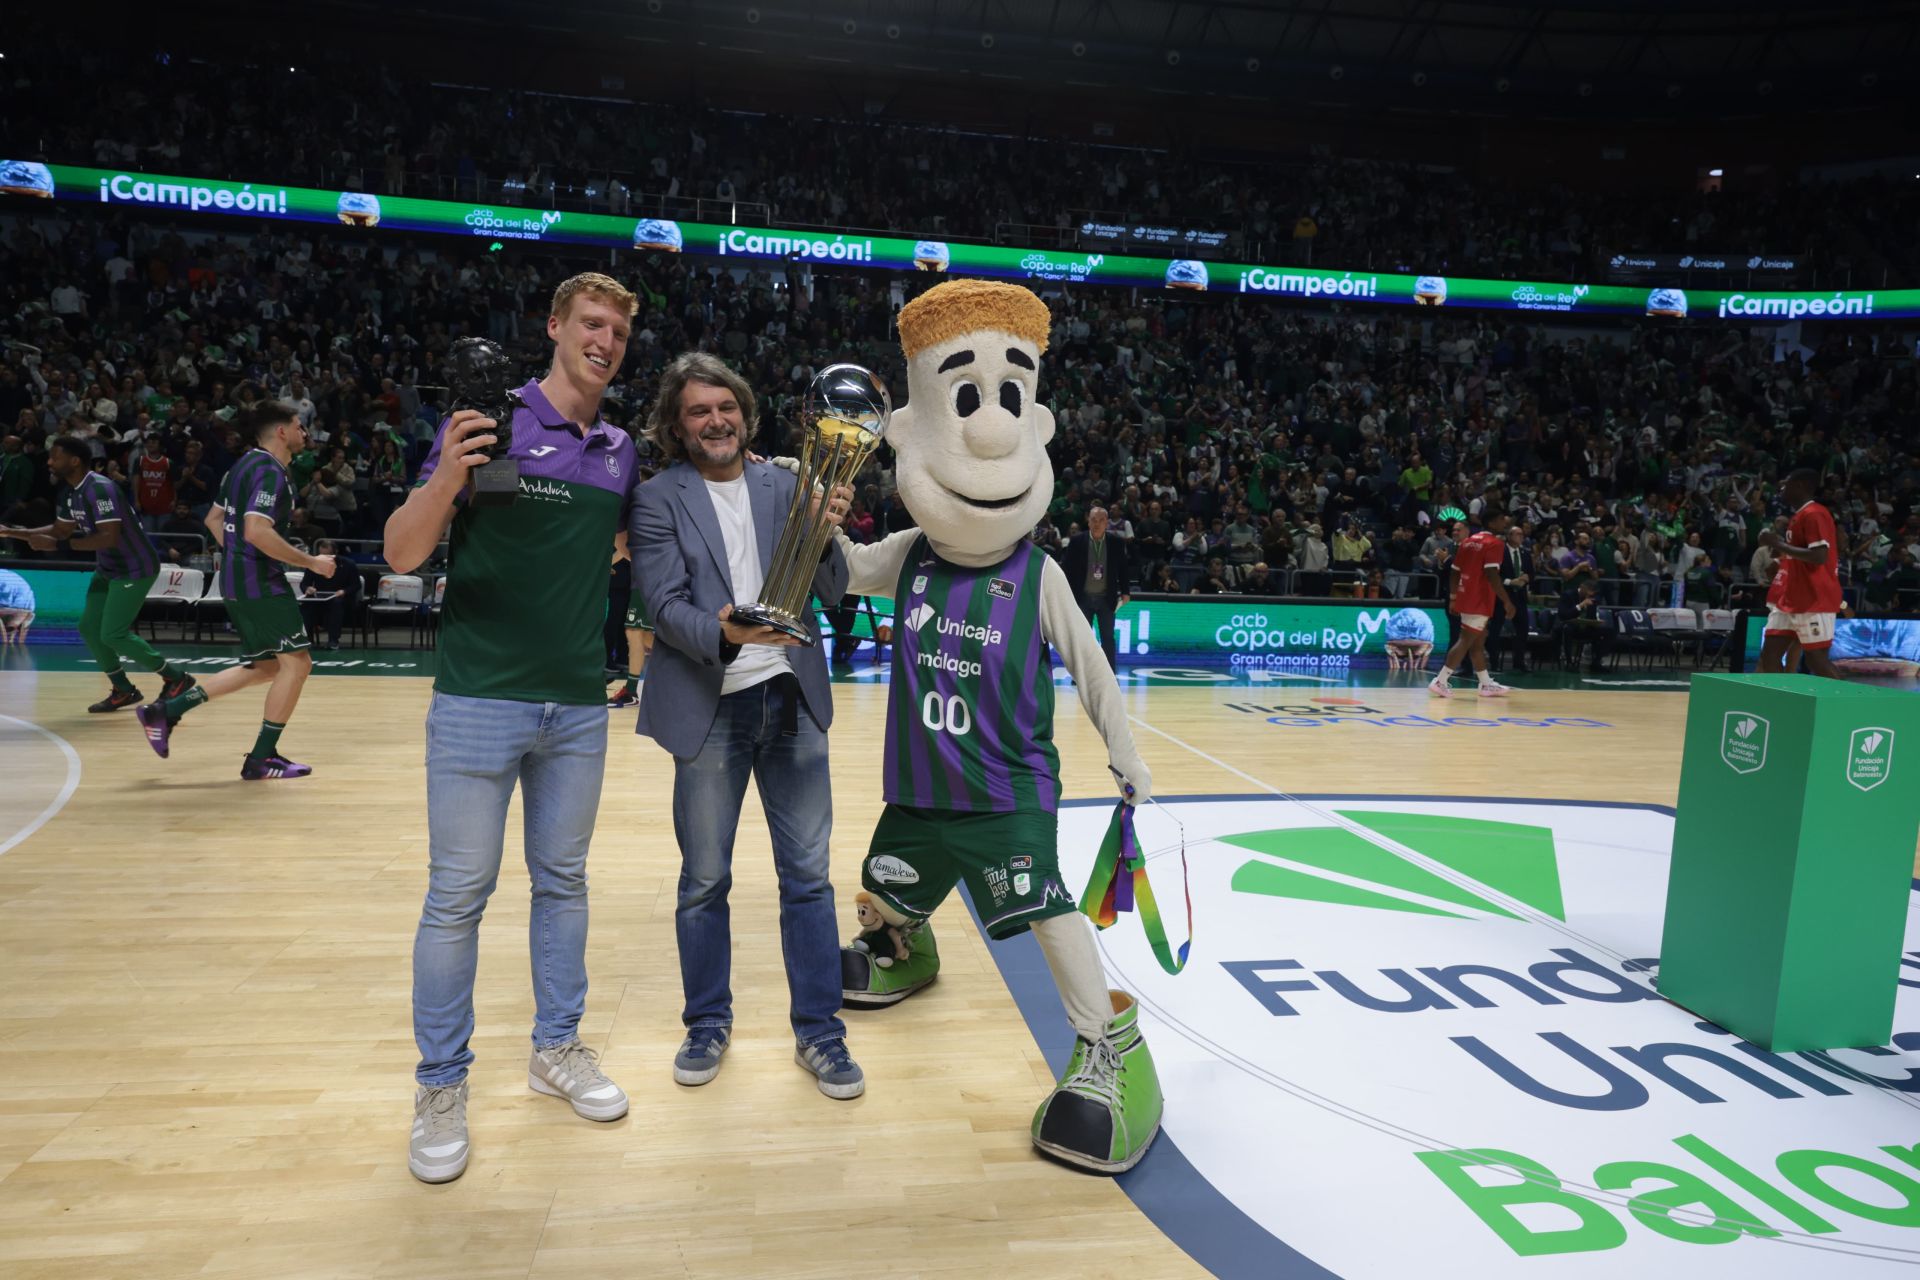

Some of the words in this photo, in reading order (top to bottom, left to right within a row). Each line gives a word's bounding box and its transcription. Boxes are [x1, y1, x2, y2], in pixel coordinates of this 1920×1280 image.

[101, 175, 287, 211] ¡Campeón!
[473, 209, 494, 217] acb
[464, 214, 504, 229] Copa
[505, 219, 521, 228] del
[523, 219, 549, 234] Rey
[473, 228, 492, 236] Gran
[493, 230, 523, 239] Canaria
[719, 230, 872, 262] ¡Campeón!
[1021, 258, 1054, 272] Copa
[1071, 262, 1092, 276] Rey
[1240, 269, 1377, 298] ¡Campeón!
[1512, 290, 1543, 303] Copa
[1558, 293, 1578, 306] Rey
[1719, 293, 1873, 318] ¡Campeón!
[519, 477, 573, 500] Andalucía
[169, 571, 184, 587] 12
[1231, 613, 1268, 628] acb
[936, 616, 1002, 646] Unicaja
[1215, 625, 1285, 651] Copa
[1289, 631, 1317, 646] del
[1322, 628, 1367, 653] Rey
[1230, 653, 1263, 665] Gran
[1265, 654, 1319, 666] Canaria
[1320, 655, 1351, 666] 2025
[922, 691, 971, 735] 00
[1223, 702, 1384, 716] liga
[1265, 714, 1616, 728] endesa
[1729, 738, 1760, 751] Fundación
[1732, 746, 1755, 758] Unicaja
